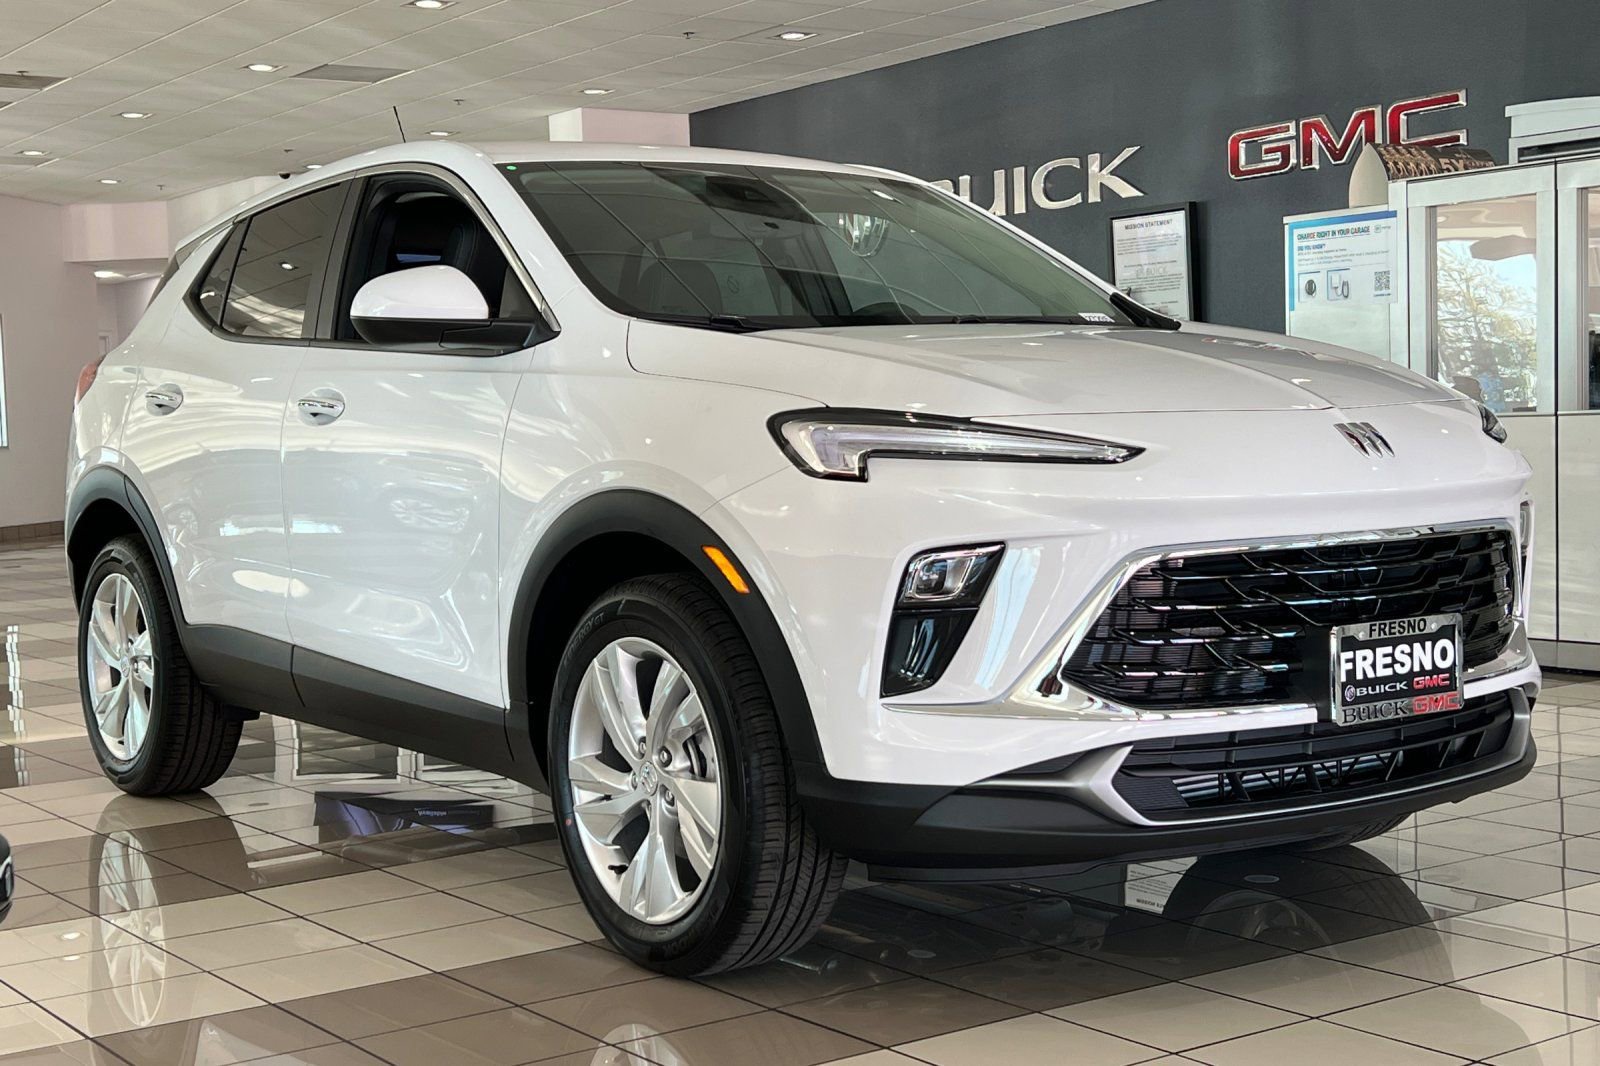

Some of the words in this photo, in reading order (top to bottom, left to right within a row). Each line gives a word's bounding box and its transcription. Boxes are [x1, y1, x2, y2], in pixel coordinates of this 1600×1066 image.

[1228, 88, 1467, 180] GMC
[1145, 219, 1172, 228] STATEMENT
[1297, 232, 1316, 240] CHARGE
[1317, 231, 1330, 239] RIGHT
[1337, 228, 1350, 236] YOUR
[1350, 226, 1370, 235] GARAGE
[1369, 618, 1427, 638] FRESNO
[1340, 638, 1455, 682] FRESNO
[1356, 680, 1408, 696] BUICK
[1413, 673, 1450, 690] GMC
[1342, 700, 1409, 724] BUICK
[1413, 693, 1459, 714] GMC
